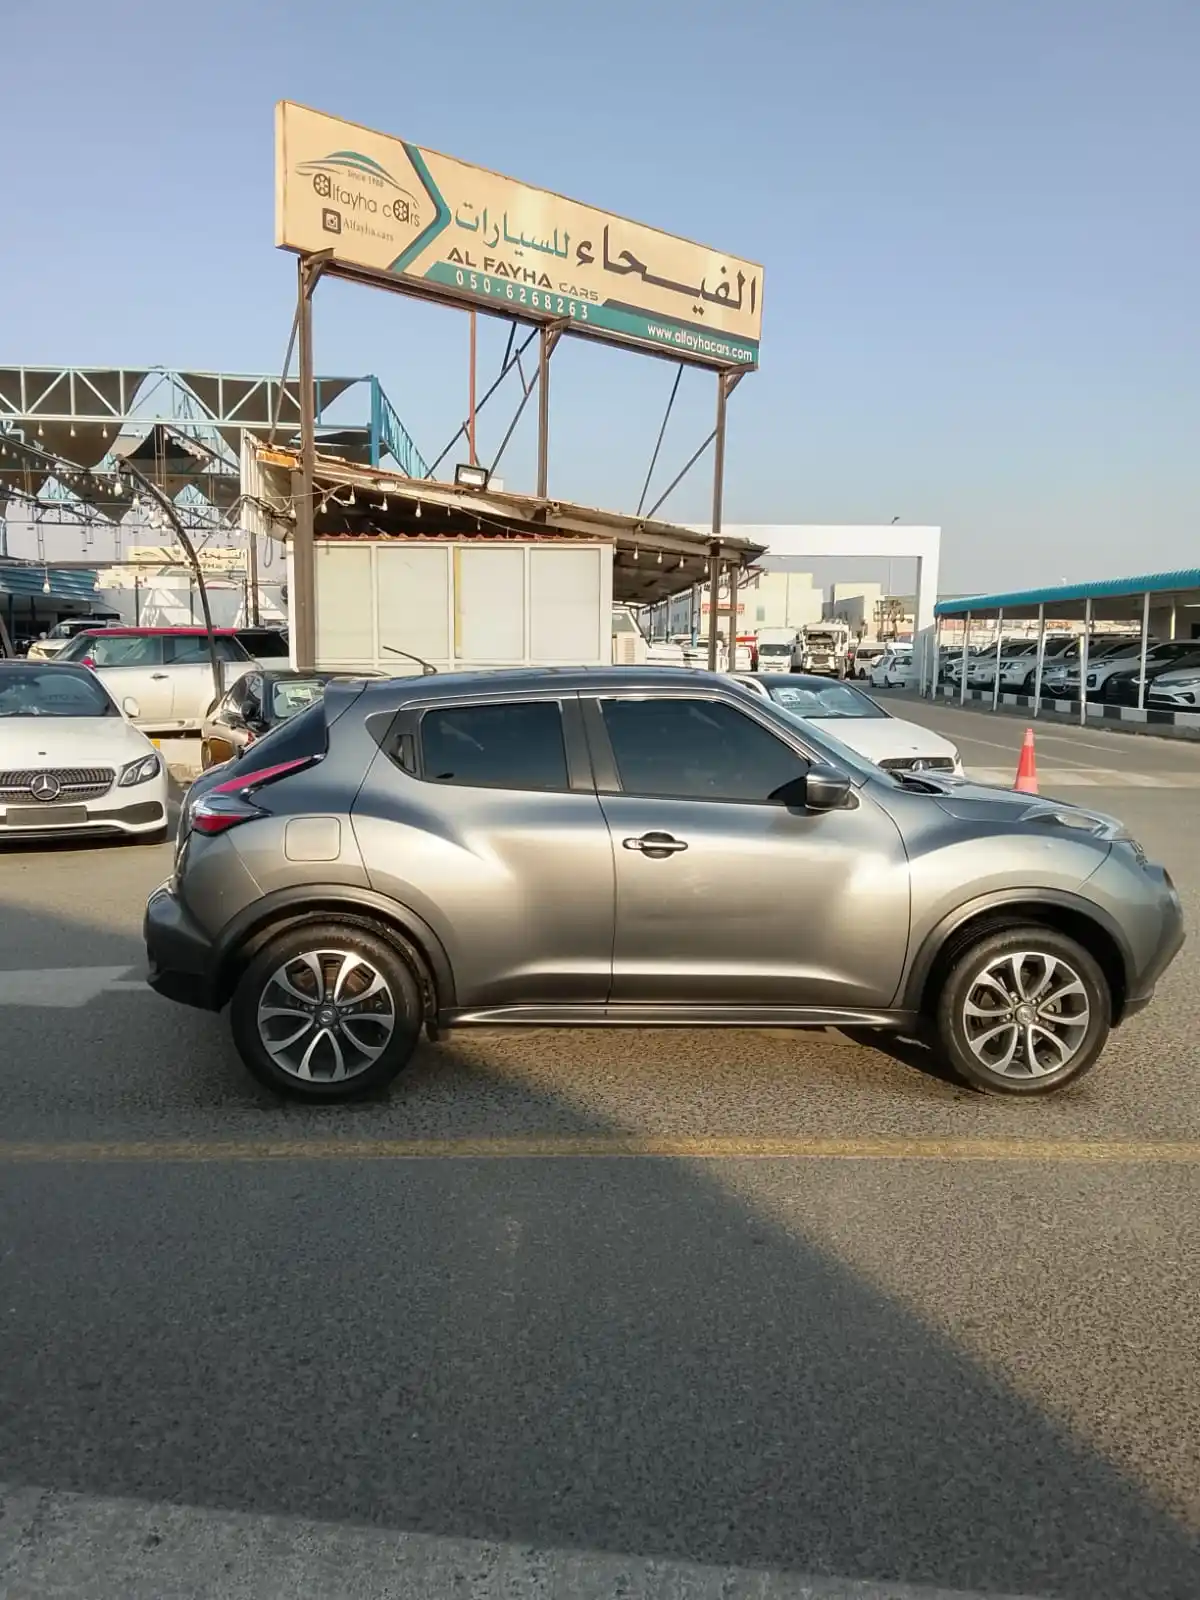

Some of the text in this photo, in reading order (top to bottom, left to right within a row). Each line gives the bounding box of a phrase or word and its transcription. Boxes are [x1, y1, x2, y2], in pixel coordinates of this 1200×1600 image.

[313, 173, 420, 228] alfayha cars
[447, 247, 599, 301] AL FAYHA CARS
[455, 202, 757, 316] الفيحاء للسيارات
[647, 324, 753, 361] www.alfayhacars.com
